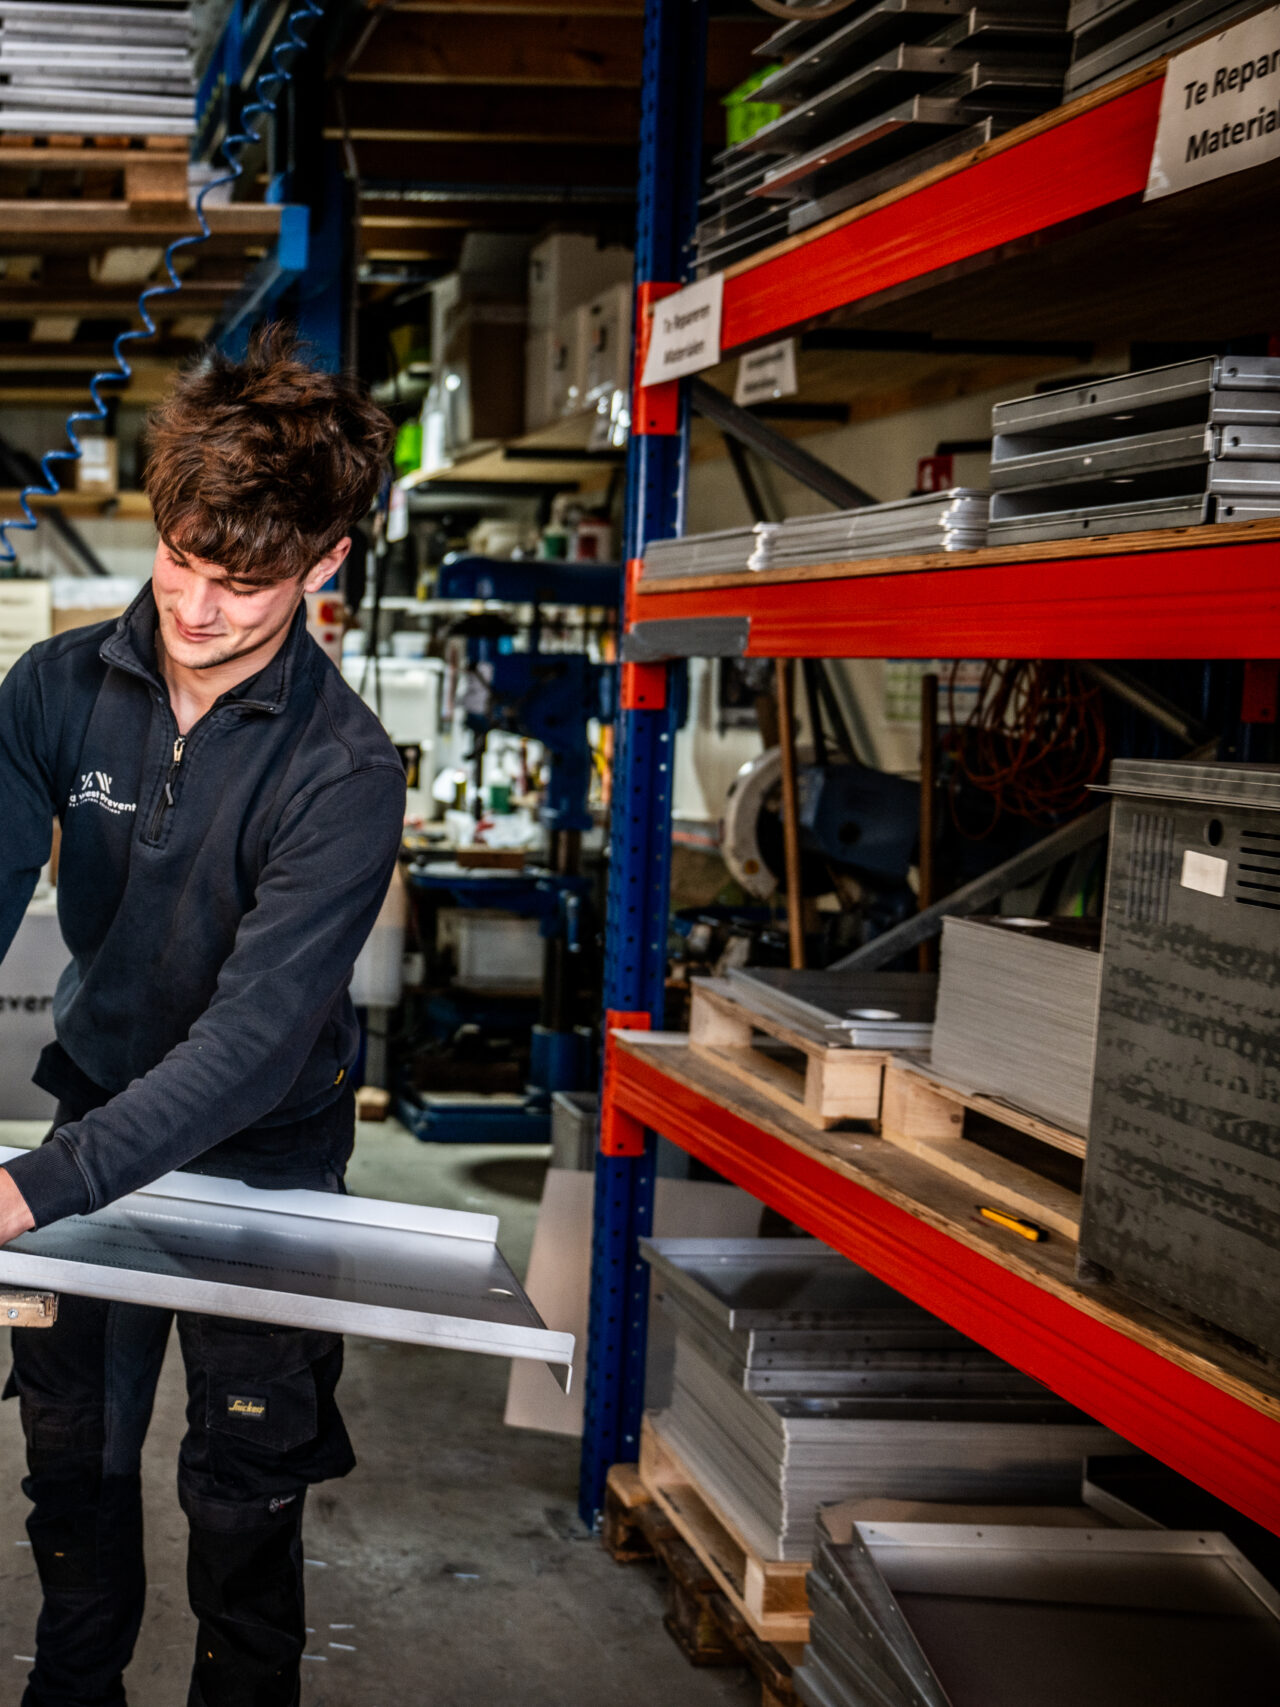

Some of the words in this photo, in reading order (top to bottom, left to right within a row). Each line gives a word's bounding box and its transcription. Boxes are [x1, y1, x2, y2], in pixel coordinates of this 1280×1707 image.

[1184, 80, 1208, 110] Te
[1185, 98, 1280, 163] Material
[100, 793, 137, 812] Prevent
